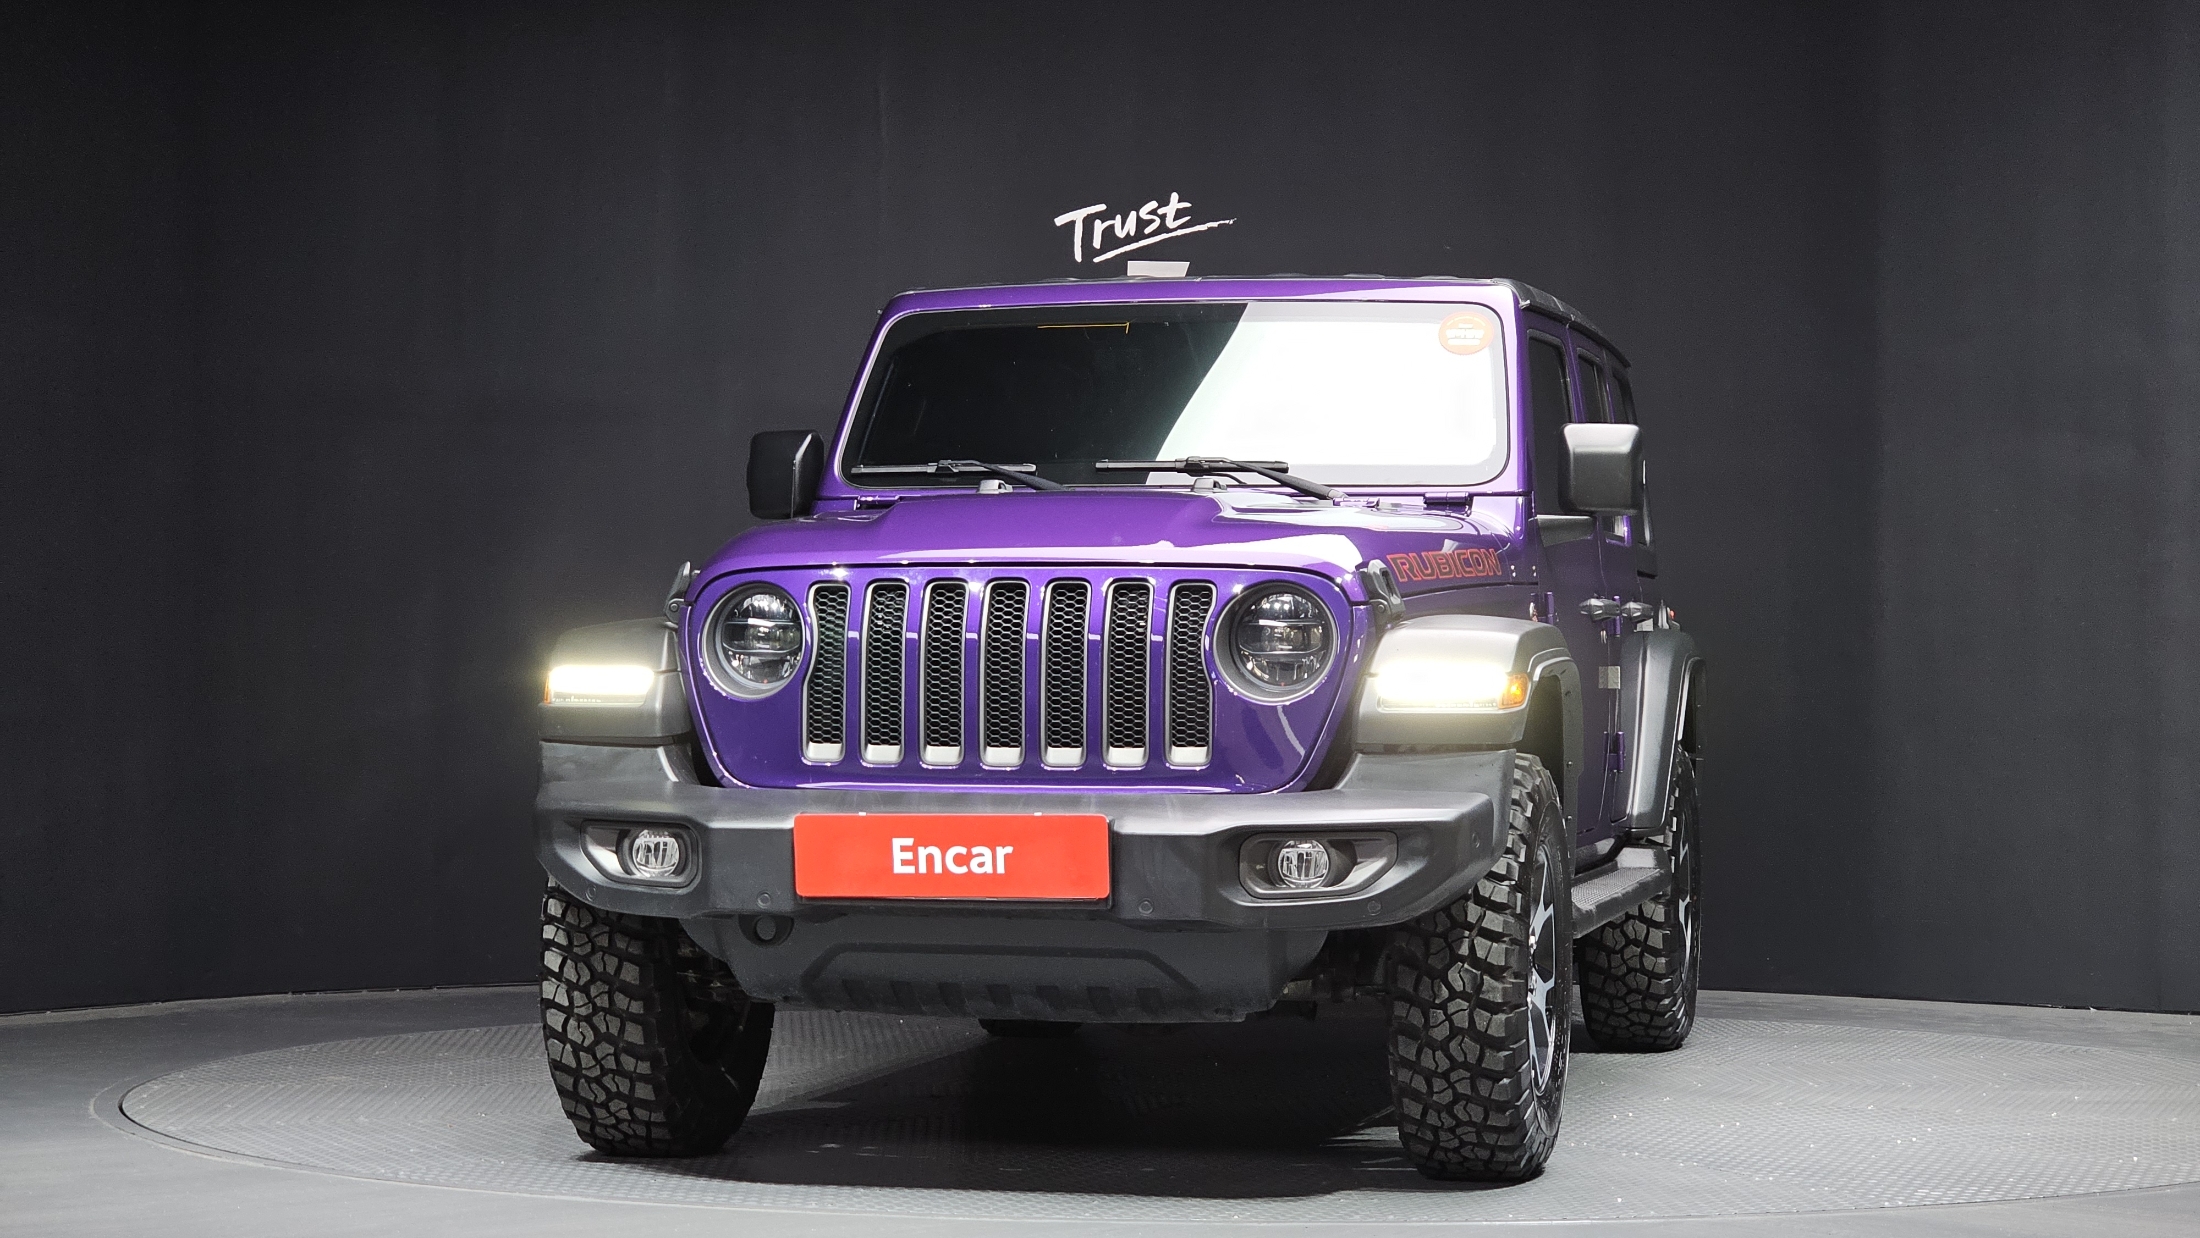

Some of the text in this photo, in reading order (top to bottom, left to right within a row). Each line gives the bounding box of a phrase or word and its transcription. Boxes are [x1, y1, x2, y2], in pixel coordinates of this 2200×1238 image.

[1054, 192, 1193, 263] Trust
[1386, 548, 1502, 582] RUBICON
[892, 837, 1013, 874] Encar
